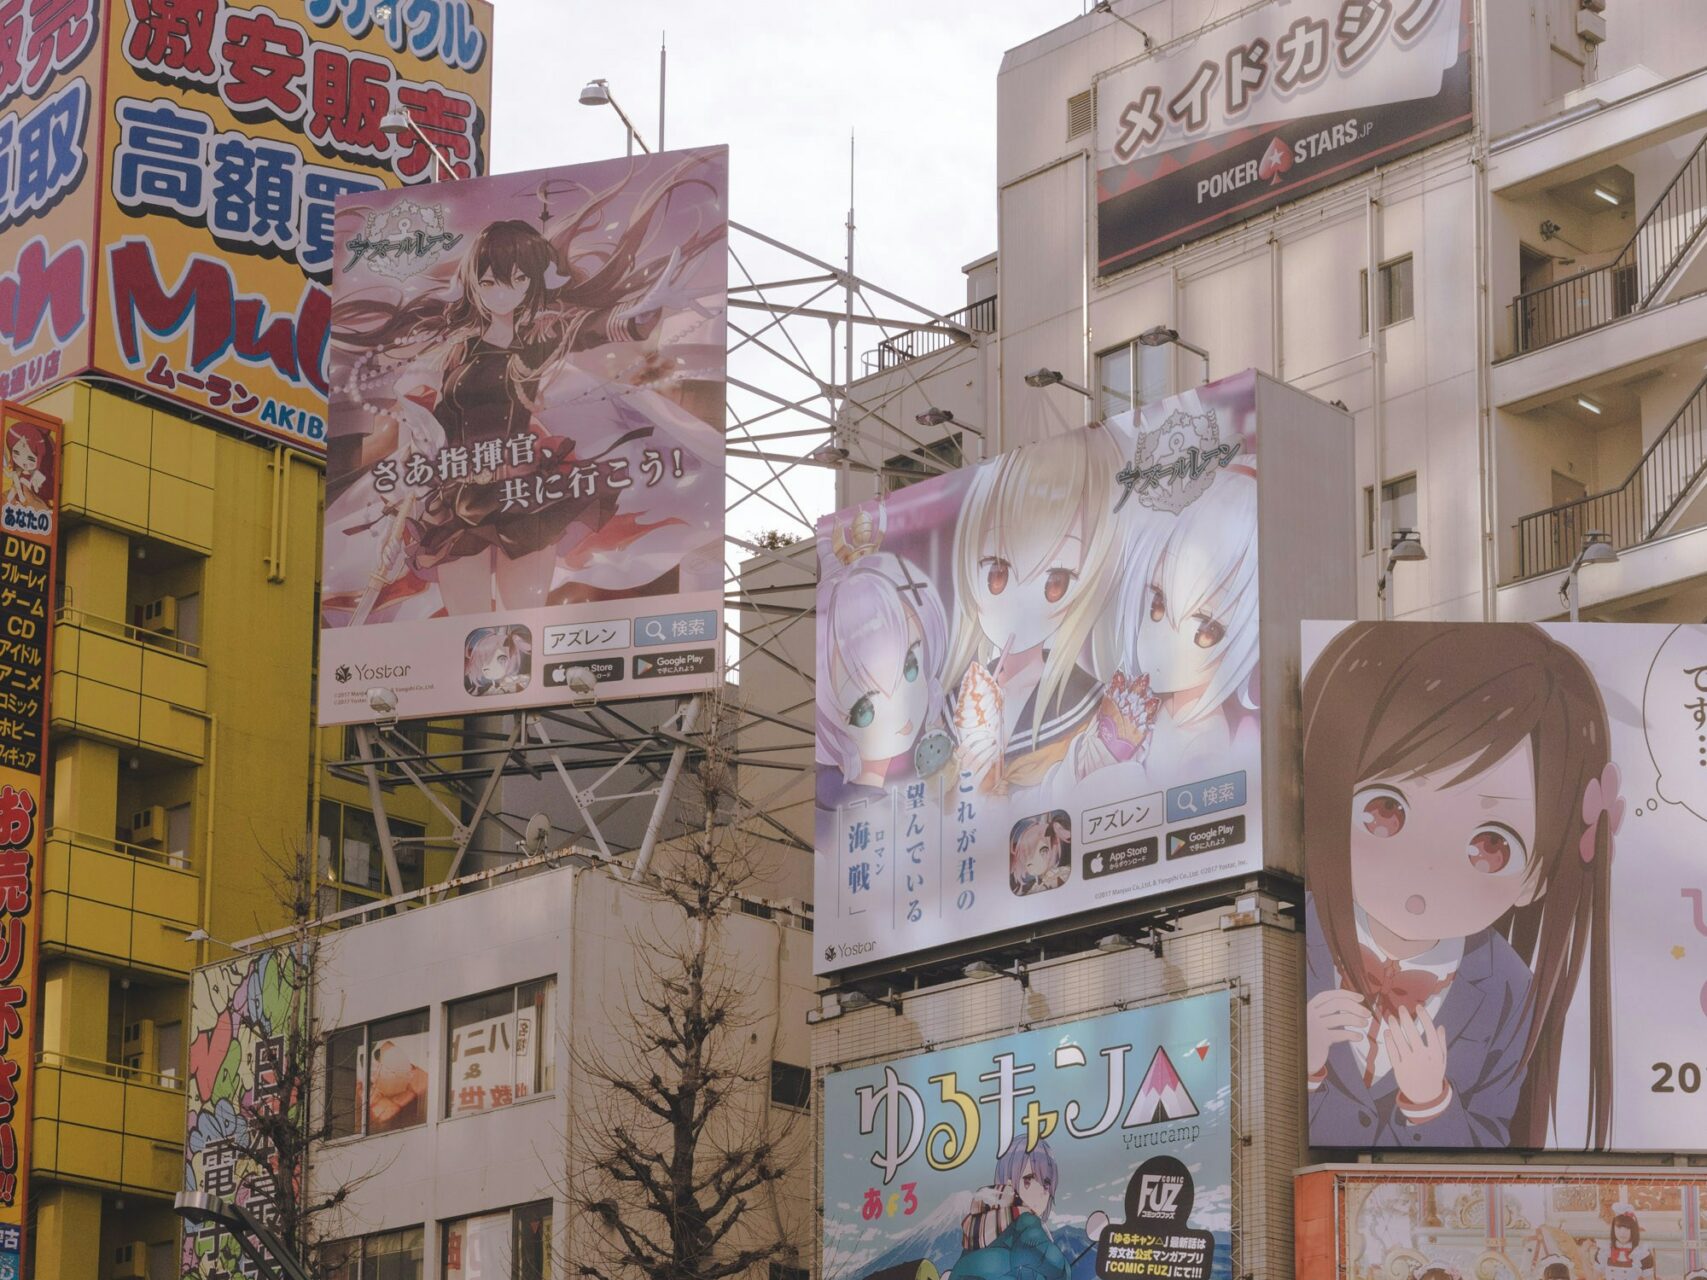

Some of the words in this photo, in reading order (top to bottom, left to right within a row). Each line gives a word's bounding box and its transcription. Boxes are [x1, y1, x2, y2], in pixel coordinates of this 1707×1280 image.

[125, 0, 472, 182] 激安販売
[1197, 163, 1258, 203] POKER
[1294, 119, 1373, 164] STARS.JP
[147, 355, 260, 415] ムーラン
[259, 397, 334, 440] AKIB
[372, 432, 555, 491] さあ指揮官、
[4, 507, 50, 531] あなたの
[4, 536, 46, 566] DVD
[1, 563, 46, 592] ブルーレイ
[1, 588, 44, 618] ゲーム
[7, 615, 36, 639] CD
[551, 628, 617, 649] アズレン
[672, 618, 705, 638] 検索
[0, 640, 41, 666] アイドル
[657, 656, 687, 667] Google
[687, 654, 704, 665] Play
[0, 664, 41, 691] アニメ
[355, 664, 412, 681] Yostar
[591, 664, 613, 673] Store
[1202, 782, 1235, 807] 検索
[1088, 806, 1150, 836] アズレン
[1189, 829, 1217, 843] Google
[1218, 824, 1235, 837] Play
[874, 830, 885, 876] ロマン
[906, 782, 925, 923] 望んでいる
[957, 771, 976, 911] これが君の
[1109, 851, 1126, 864] App
[1126, 844, 1148, 858] Store
[838, 941, 877, 958] Yostar
[1122, 1124, 1200, 1149] Yurucamp
[1137, 1174, 1184, 1217] FUZ
[1108, 1247, 1204, 1264] 芳文社公式マンガアプリ
